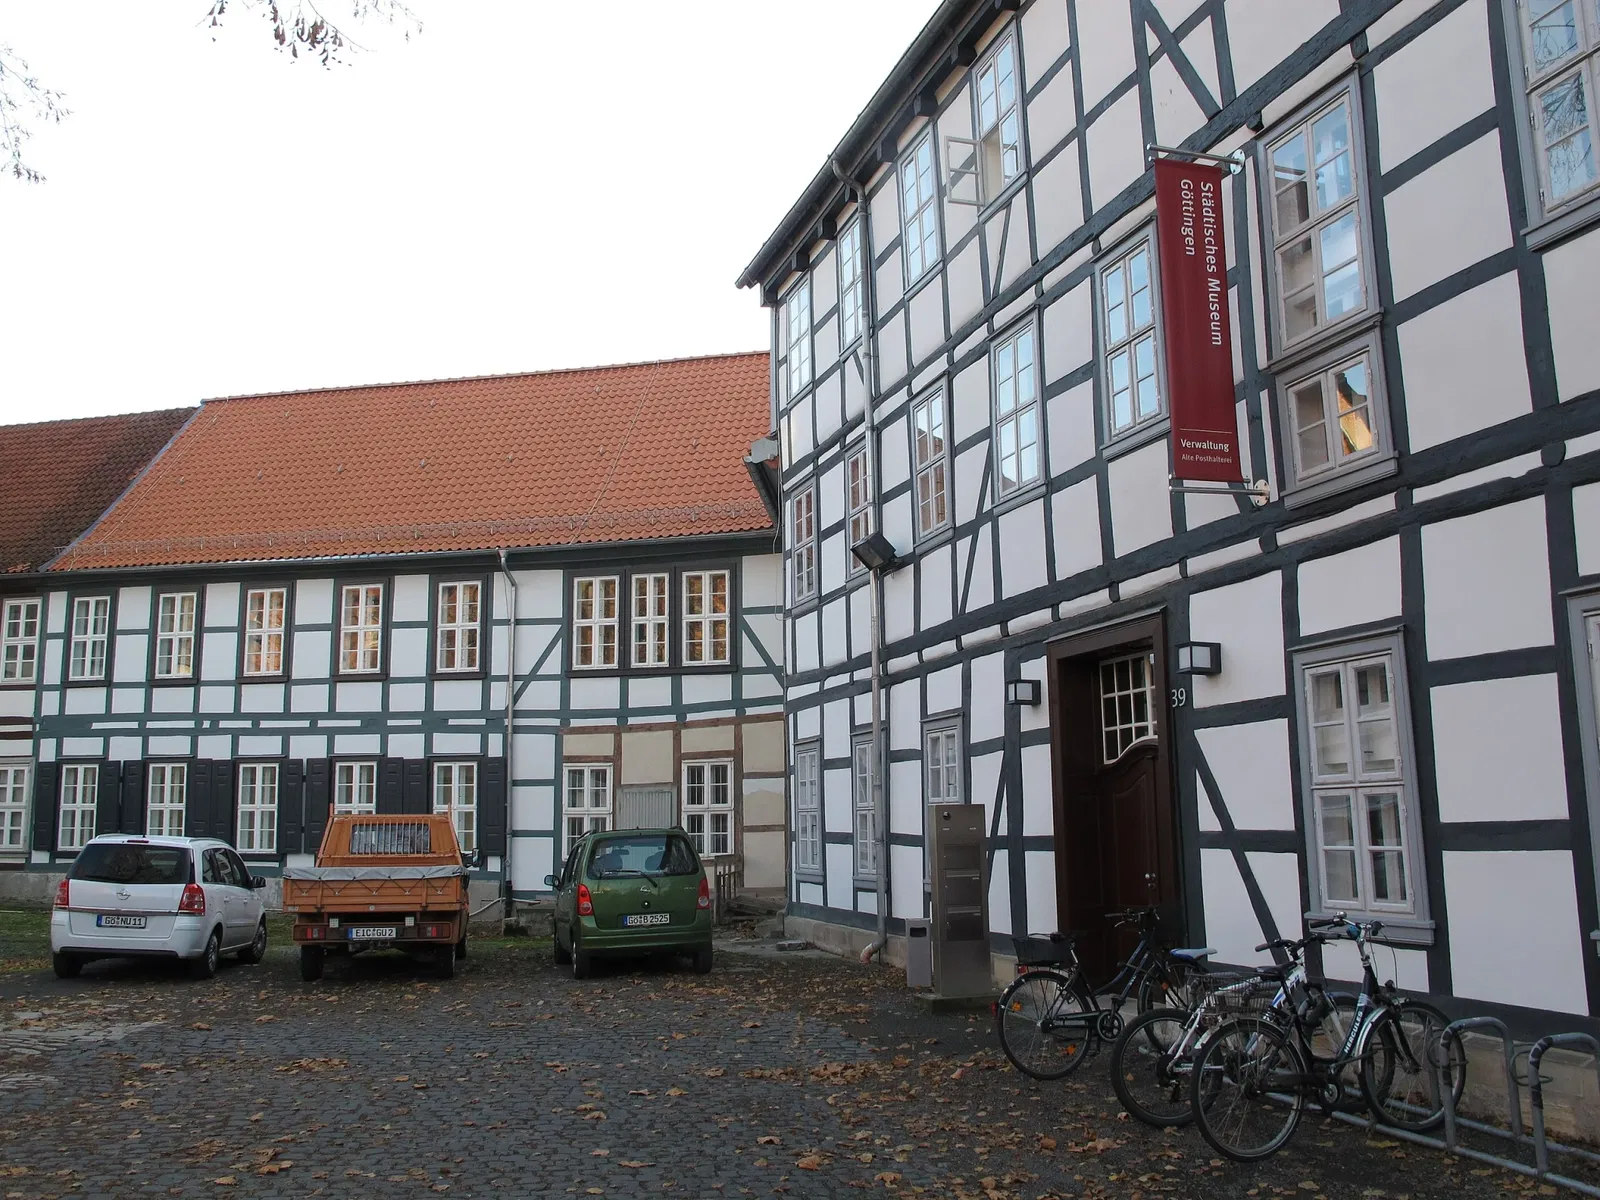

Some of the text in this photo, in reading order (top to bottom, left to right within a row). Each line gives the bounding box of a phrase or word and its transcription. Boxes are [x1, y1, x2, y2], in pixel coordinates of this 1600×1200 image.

[1180, 178, 1196, 256] Göttingen
[1200, 181, 1222, 346] Städtisches Museum
[1180, 438, 1230, 453] Verwaltung
[1181, 453, 1233, 464] Alte Posthalterei
[1171, 687, 1186, 708] 39
[1343, 1010, 1363, 1054] HERCULES
